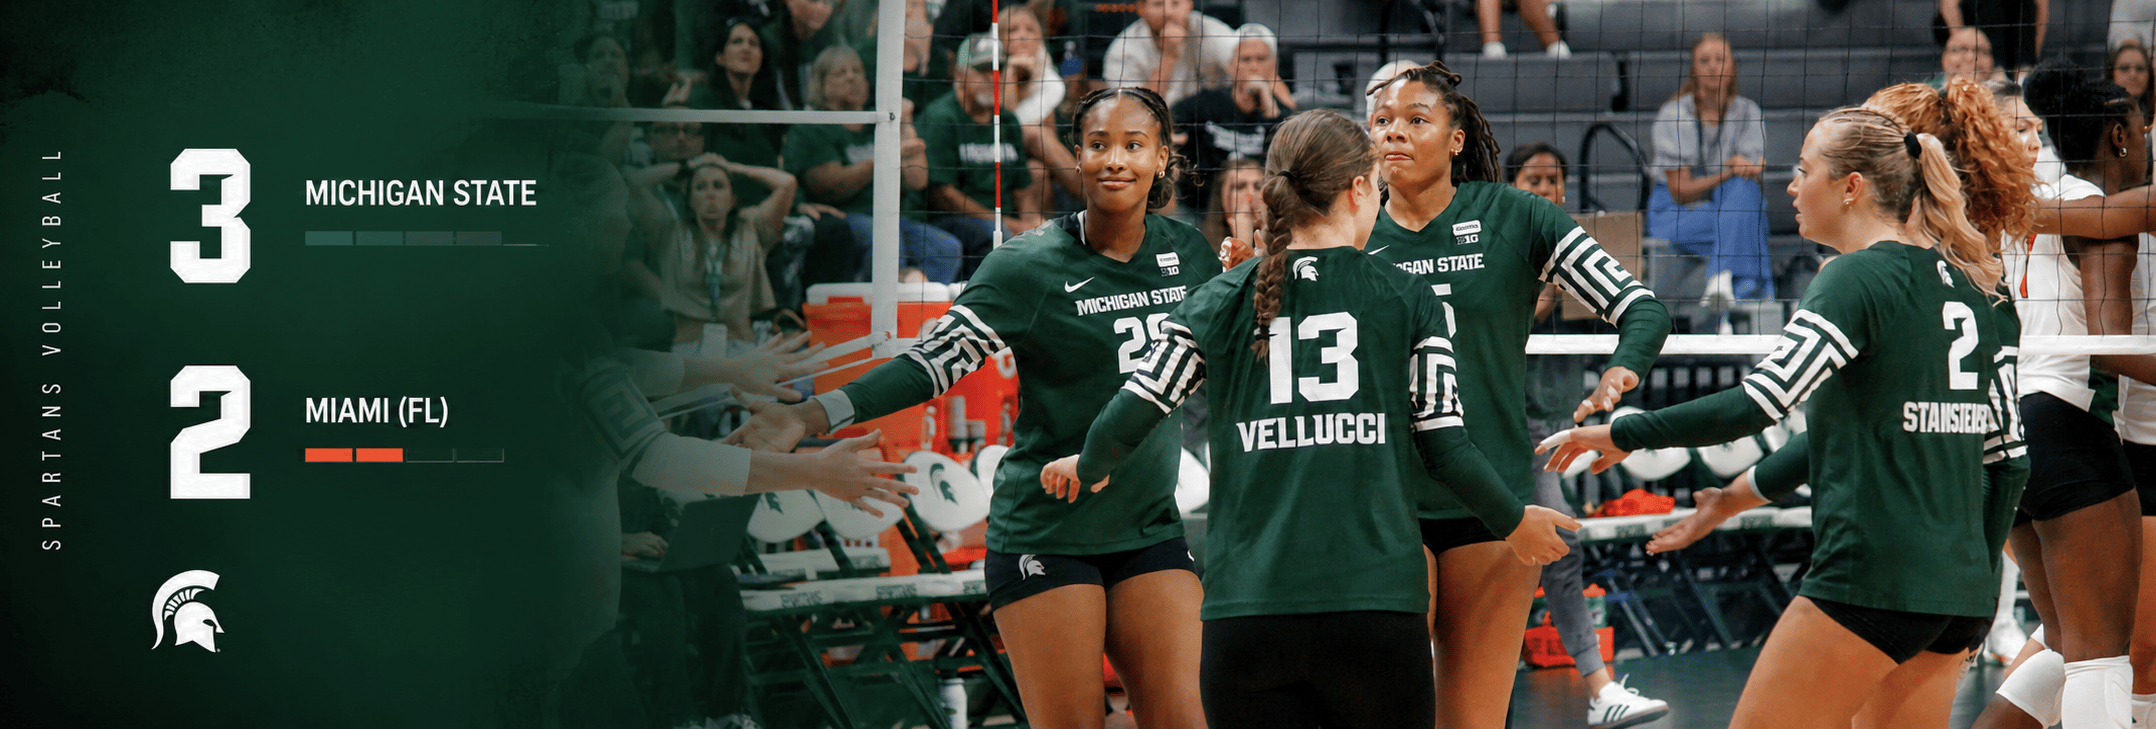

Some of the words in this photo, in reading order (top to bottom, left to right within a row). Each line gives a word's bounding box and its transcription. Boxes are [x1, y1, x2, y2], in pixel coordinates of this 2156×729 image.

[1437, 252, 1486, 273] STATE
[1074, 290, 1150, 317] MICHIGAN
[1253, 311, 1360, 405] 13
[1941, 300, 1980, 391] 2
[1235, 412, 1386, 453] VELLUCCI
